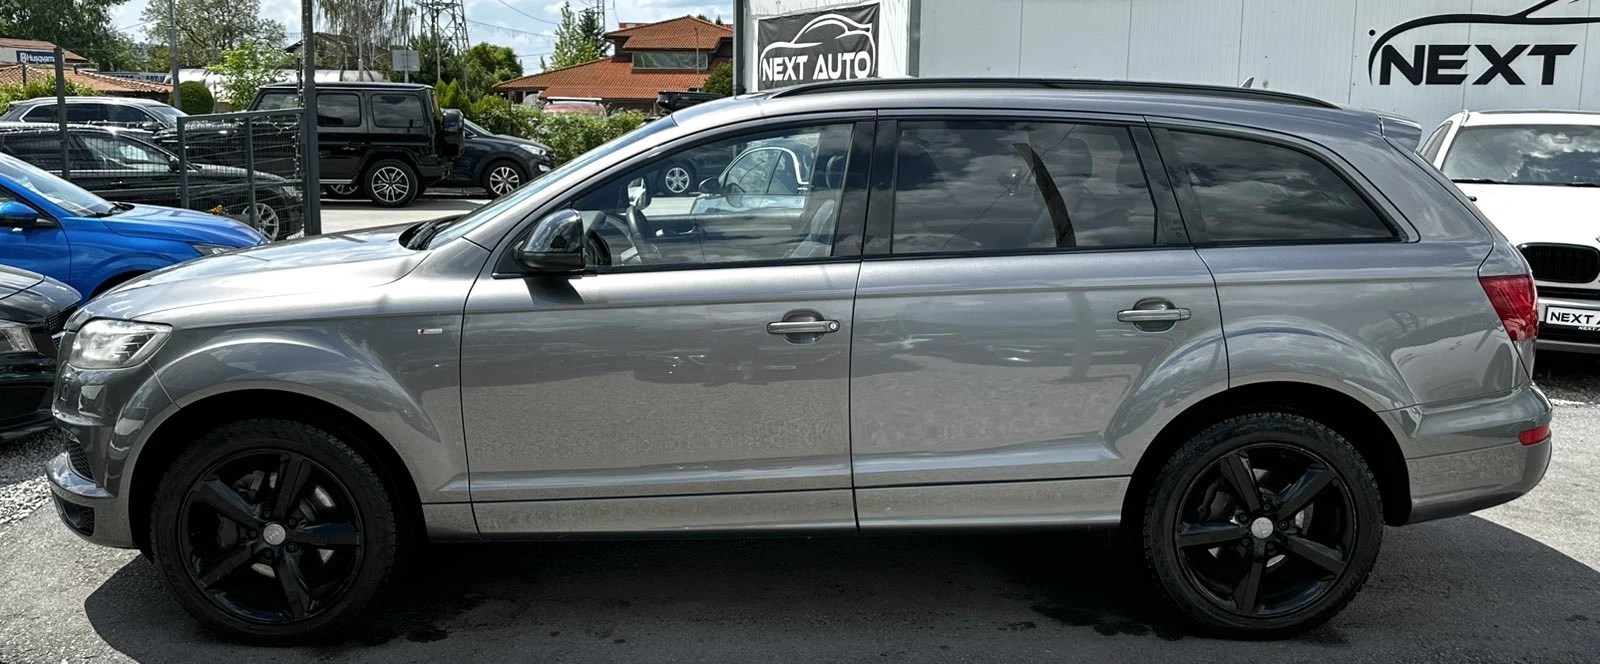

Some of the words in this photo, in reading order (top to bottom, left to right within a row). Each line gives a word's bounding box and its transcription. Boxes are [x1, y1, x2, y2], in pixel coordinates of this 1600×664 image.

[762, 55, 808, 81] NEXT
[813, 51, 871, 80] AUTO
[1379, 44, 1578, 86] NEXT
[1550, 311, 1595, 324] NEXT
